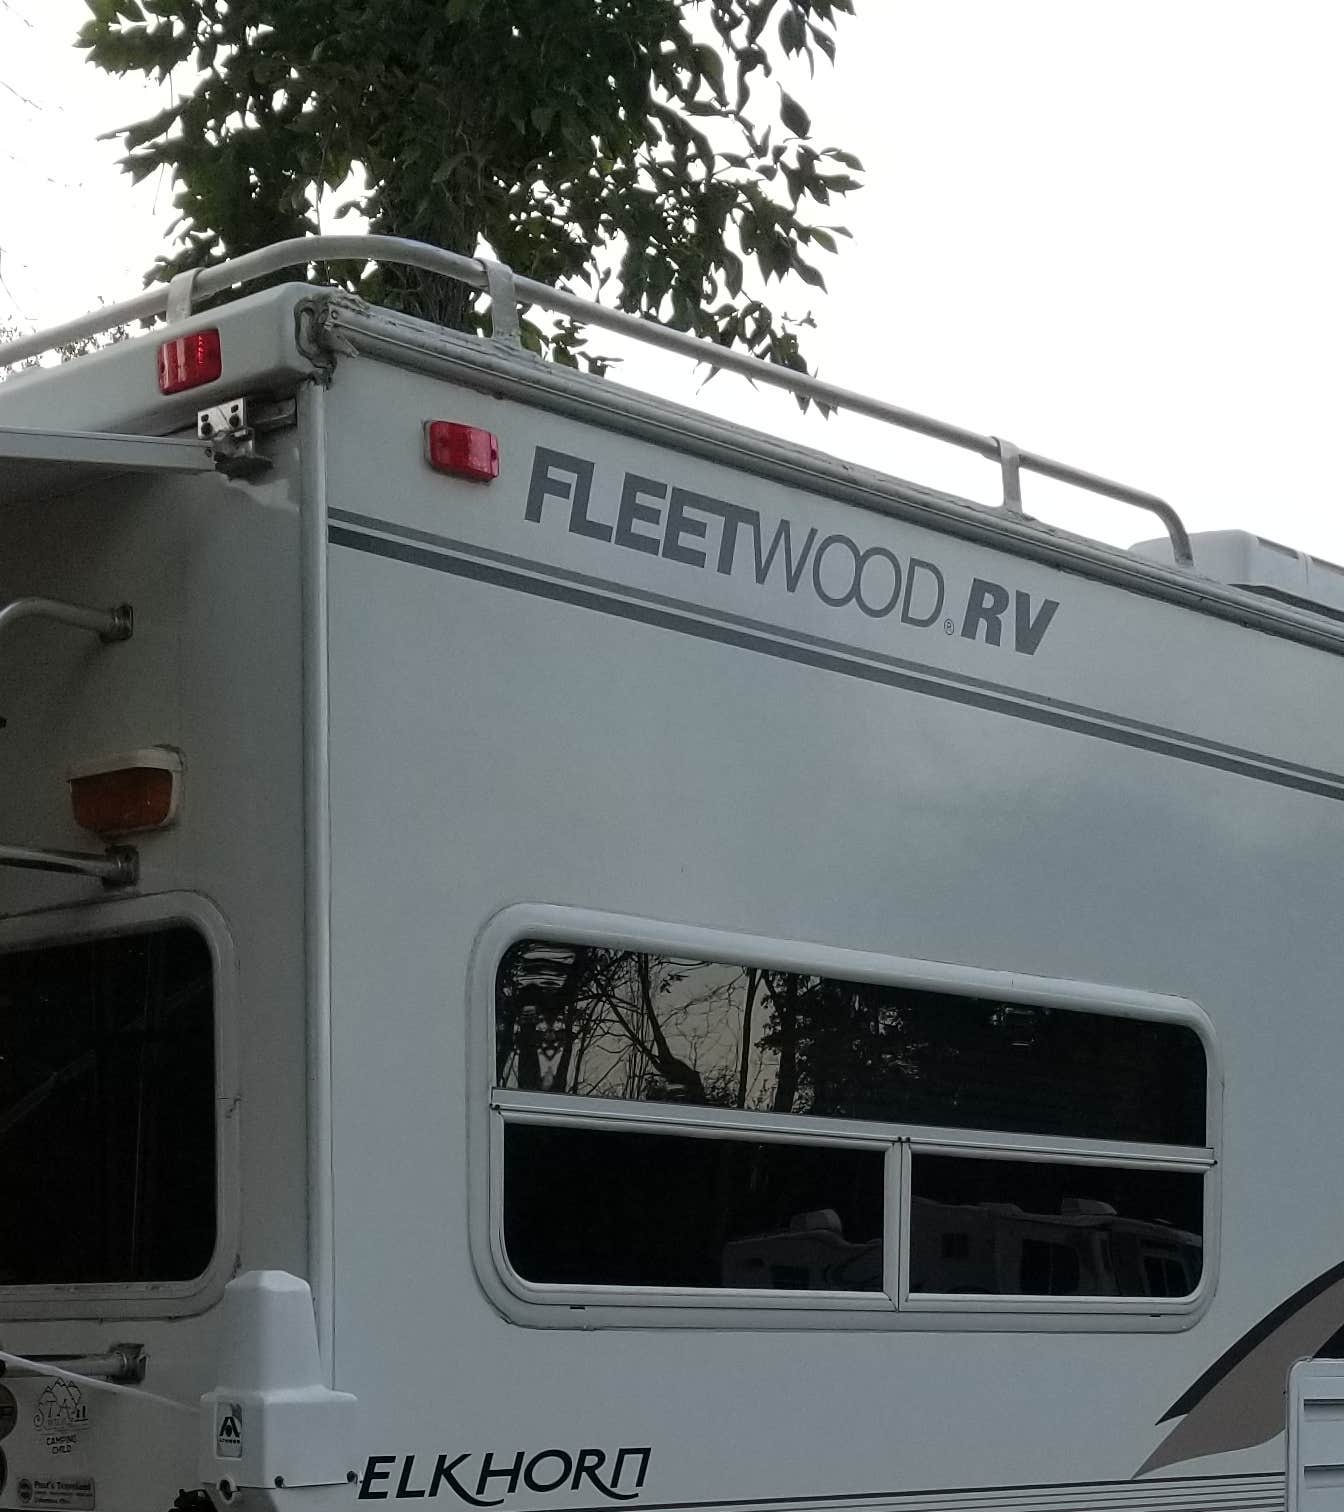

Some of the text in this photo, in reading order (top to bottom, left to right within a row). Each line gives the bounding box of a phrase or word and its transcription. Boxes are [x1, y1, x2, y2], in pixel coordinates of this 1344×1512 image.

[524, 445, 1061, 657] FLEETWOOD RV
[358, 1446, 652, 1507] ELKHORN
